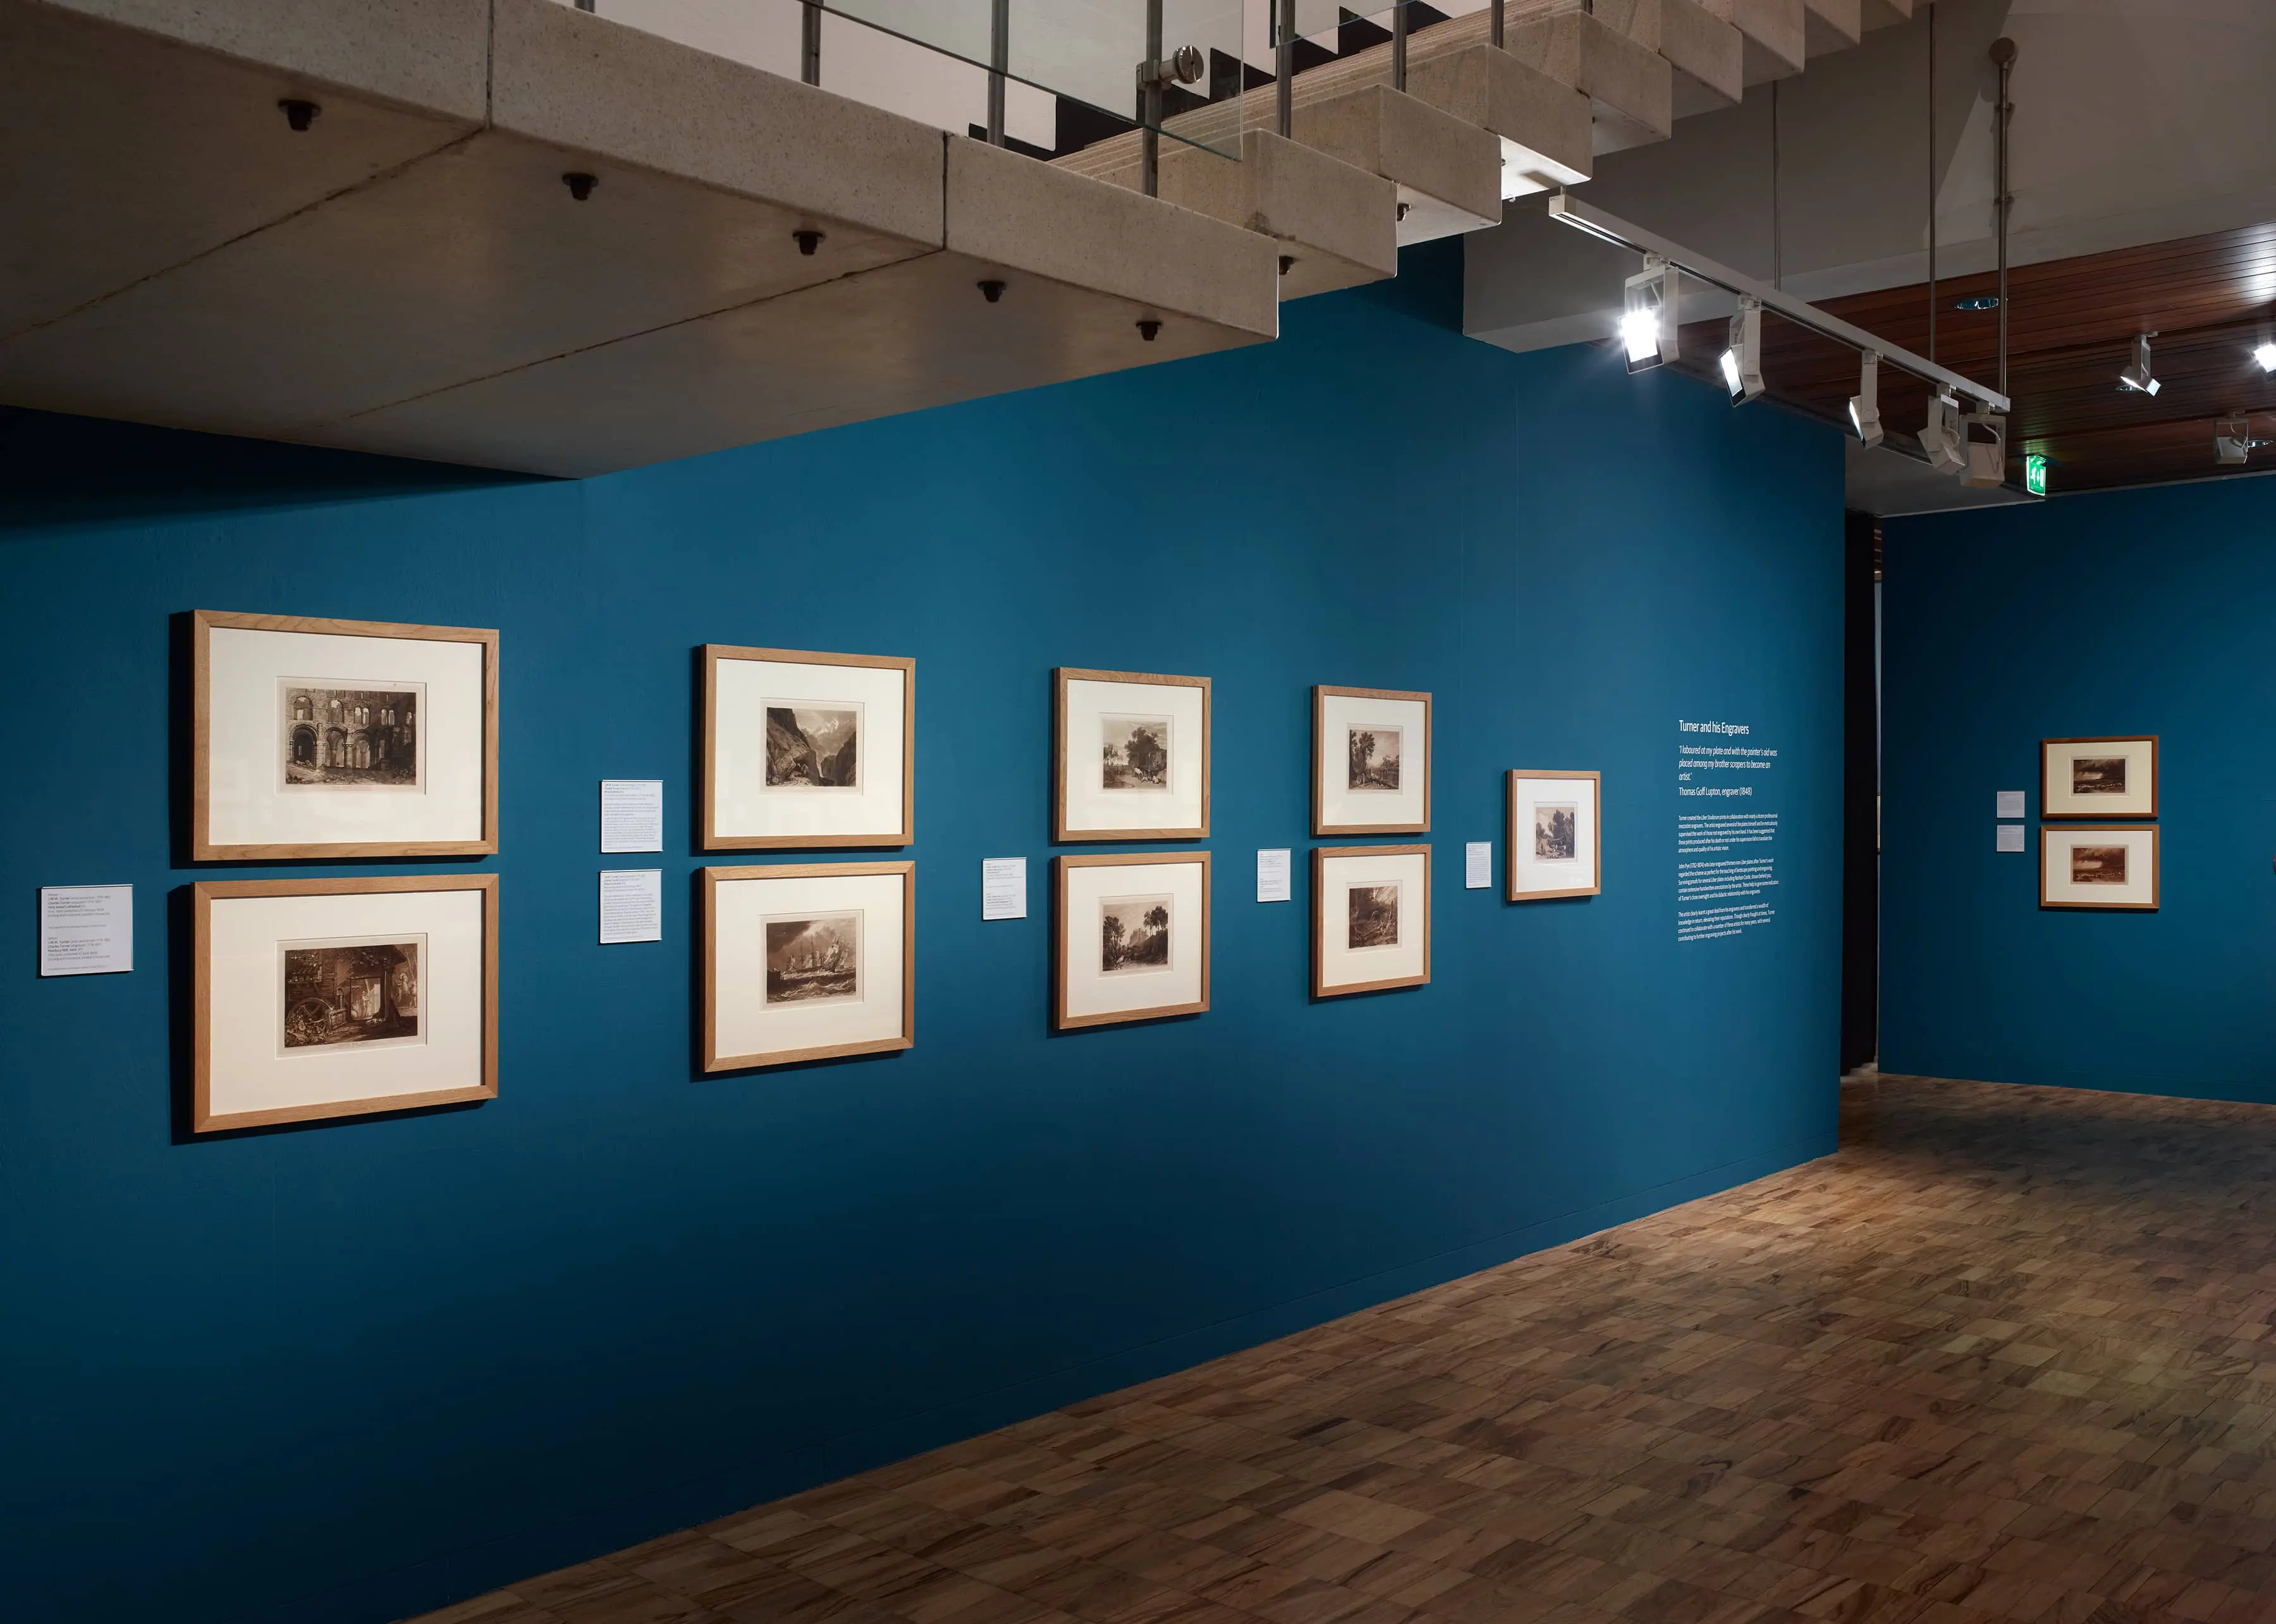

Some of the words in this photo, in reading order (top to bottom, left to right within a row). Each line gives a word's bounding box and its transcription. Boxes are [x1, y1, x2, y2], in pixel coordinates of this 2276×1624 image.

[1679, 720, 1699, 732] Turner
[1700, 721, 1711, 733] and
[1712, 721, 1720, 733] his
[1722, 722, 1749, 736] Engravers
[1682, 745, 1701, 754] laboured
[1706, 747, 1713, 756] my
[1713, 746, 1723, 756] plate
[1732, 747, 1740, 755] with
[1747, 747, 1763, 757] painter's
[1679, 759, 1693, 769] placed
[1693, 760, 1707, 769] among
[1708, 760, 1715, 769] my
[1715, 759, 1730, 768] brother
[1730, 761, 1746, 770] scrapers
[1751, 760, 1765, 769] become
[1679, 787, 1696, 796] Thomas
[1696, 786, 1706, 796] Goff
[1706, 787, 1721, 797] Lupton,
[1722, 788, 1739, 798] engraver
[1740, 786, 1753, 797] (1848)
